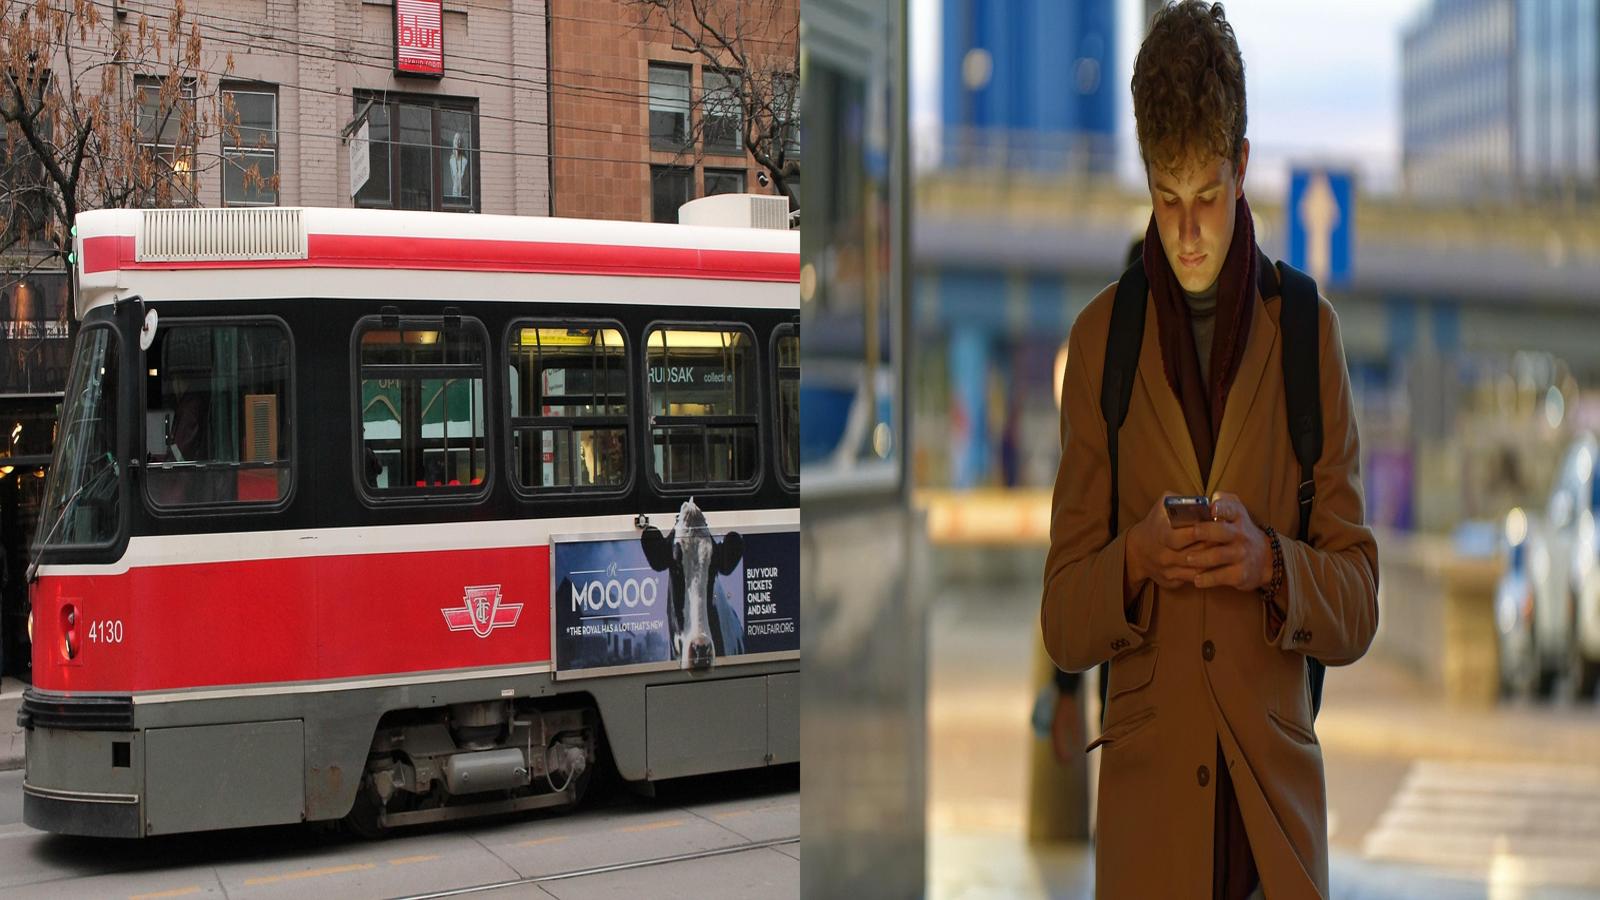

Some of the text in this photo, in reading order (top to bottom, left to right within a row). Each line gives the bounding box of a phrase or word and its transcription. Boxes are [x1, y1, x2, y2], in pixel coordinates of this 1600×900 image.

[400, 14, 440, 48] blur
[648, 367, 694, 383] RUDSAK
[747, 567, 778, 578] BUY YOUR
[747, 580, 772, 590] TICKETS
[747, 592, 771, 603] ONLINE
[747, 603, 777, 615] AND SAVE
[88, 620, 123, 645] 4130
[582, 625, 601, 635] ROYAL
[602, 624, 613, 633] HAS
[613, 623, 619, 632] A
[619, 622, 630, 632] LOT
[631, 621, 650, 630] THAT'S
[650, 620, 663, 629] NEW
[747, 623, 794, 635] ROYALFAIR.ORG
